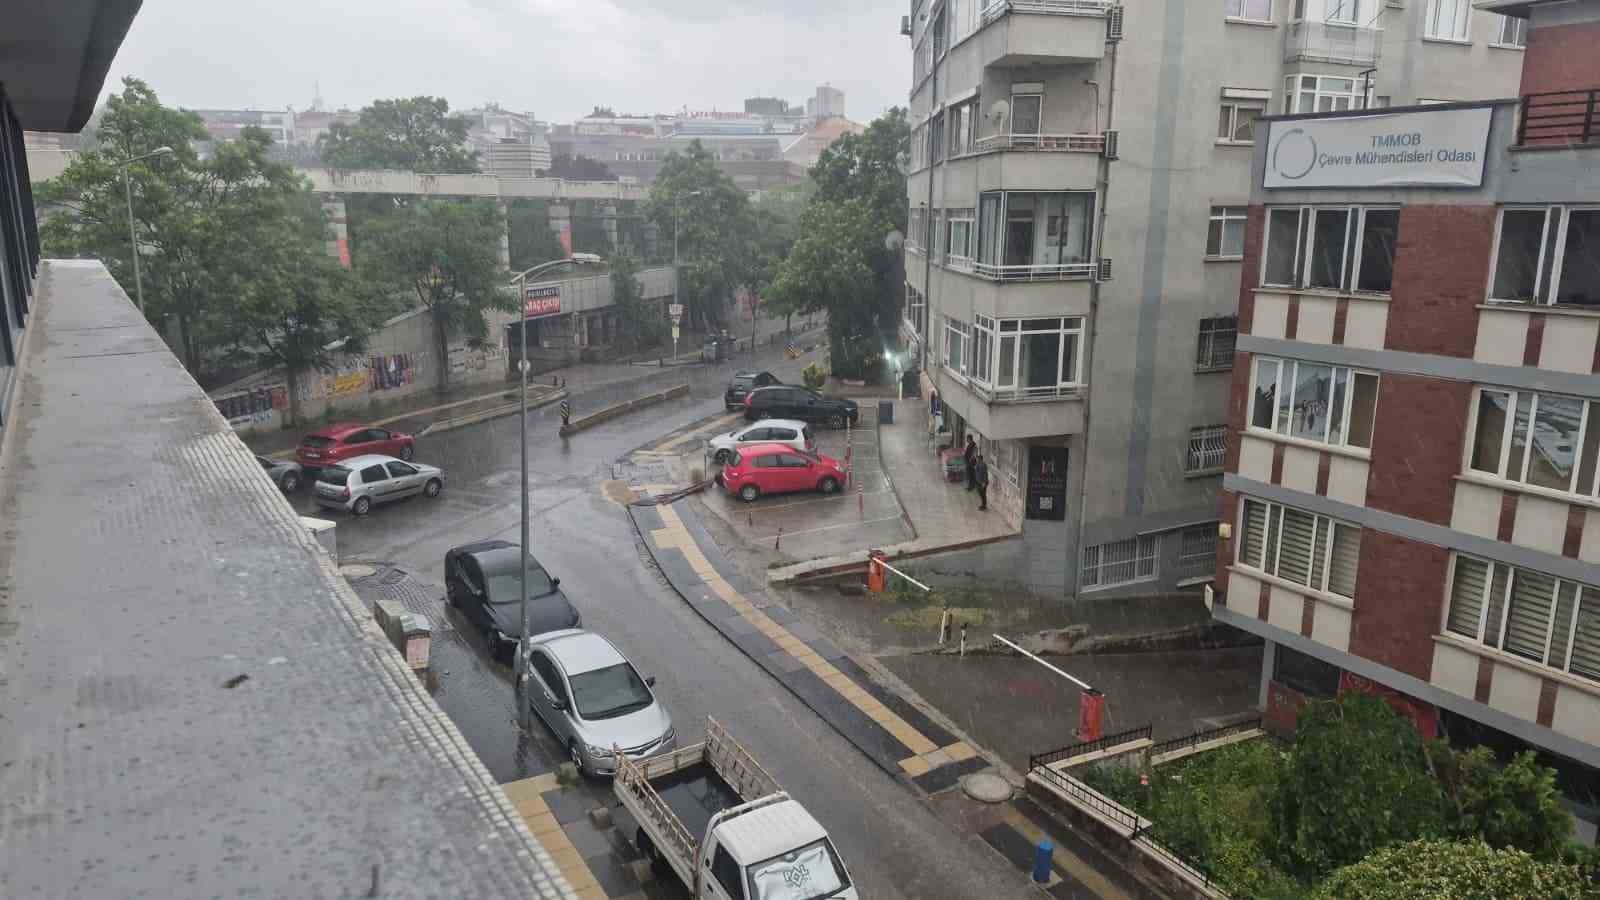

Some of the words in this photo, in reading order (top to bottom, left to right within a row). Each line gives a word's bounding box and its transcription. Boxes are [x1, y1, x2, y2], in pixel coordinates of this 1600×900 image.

[1370, 133, 1421, 148] TMMOB
[1318, 153, 1352, 169] Çevre
[1355, 150, 1432, 166] Mühendisleri
[1437, 149, 1476, 163] Odası
